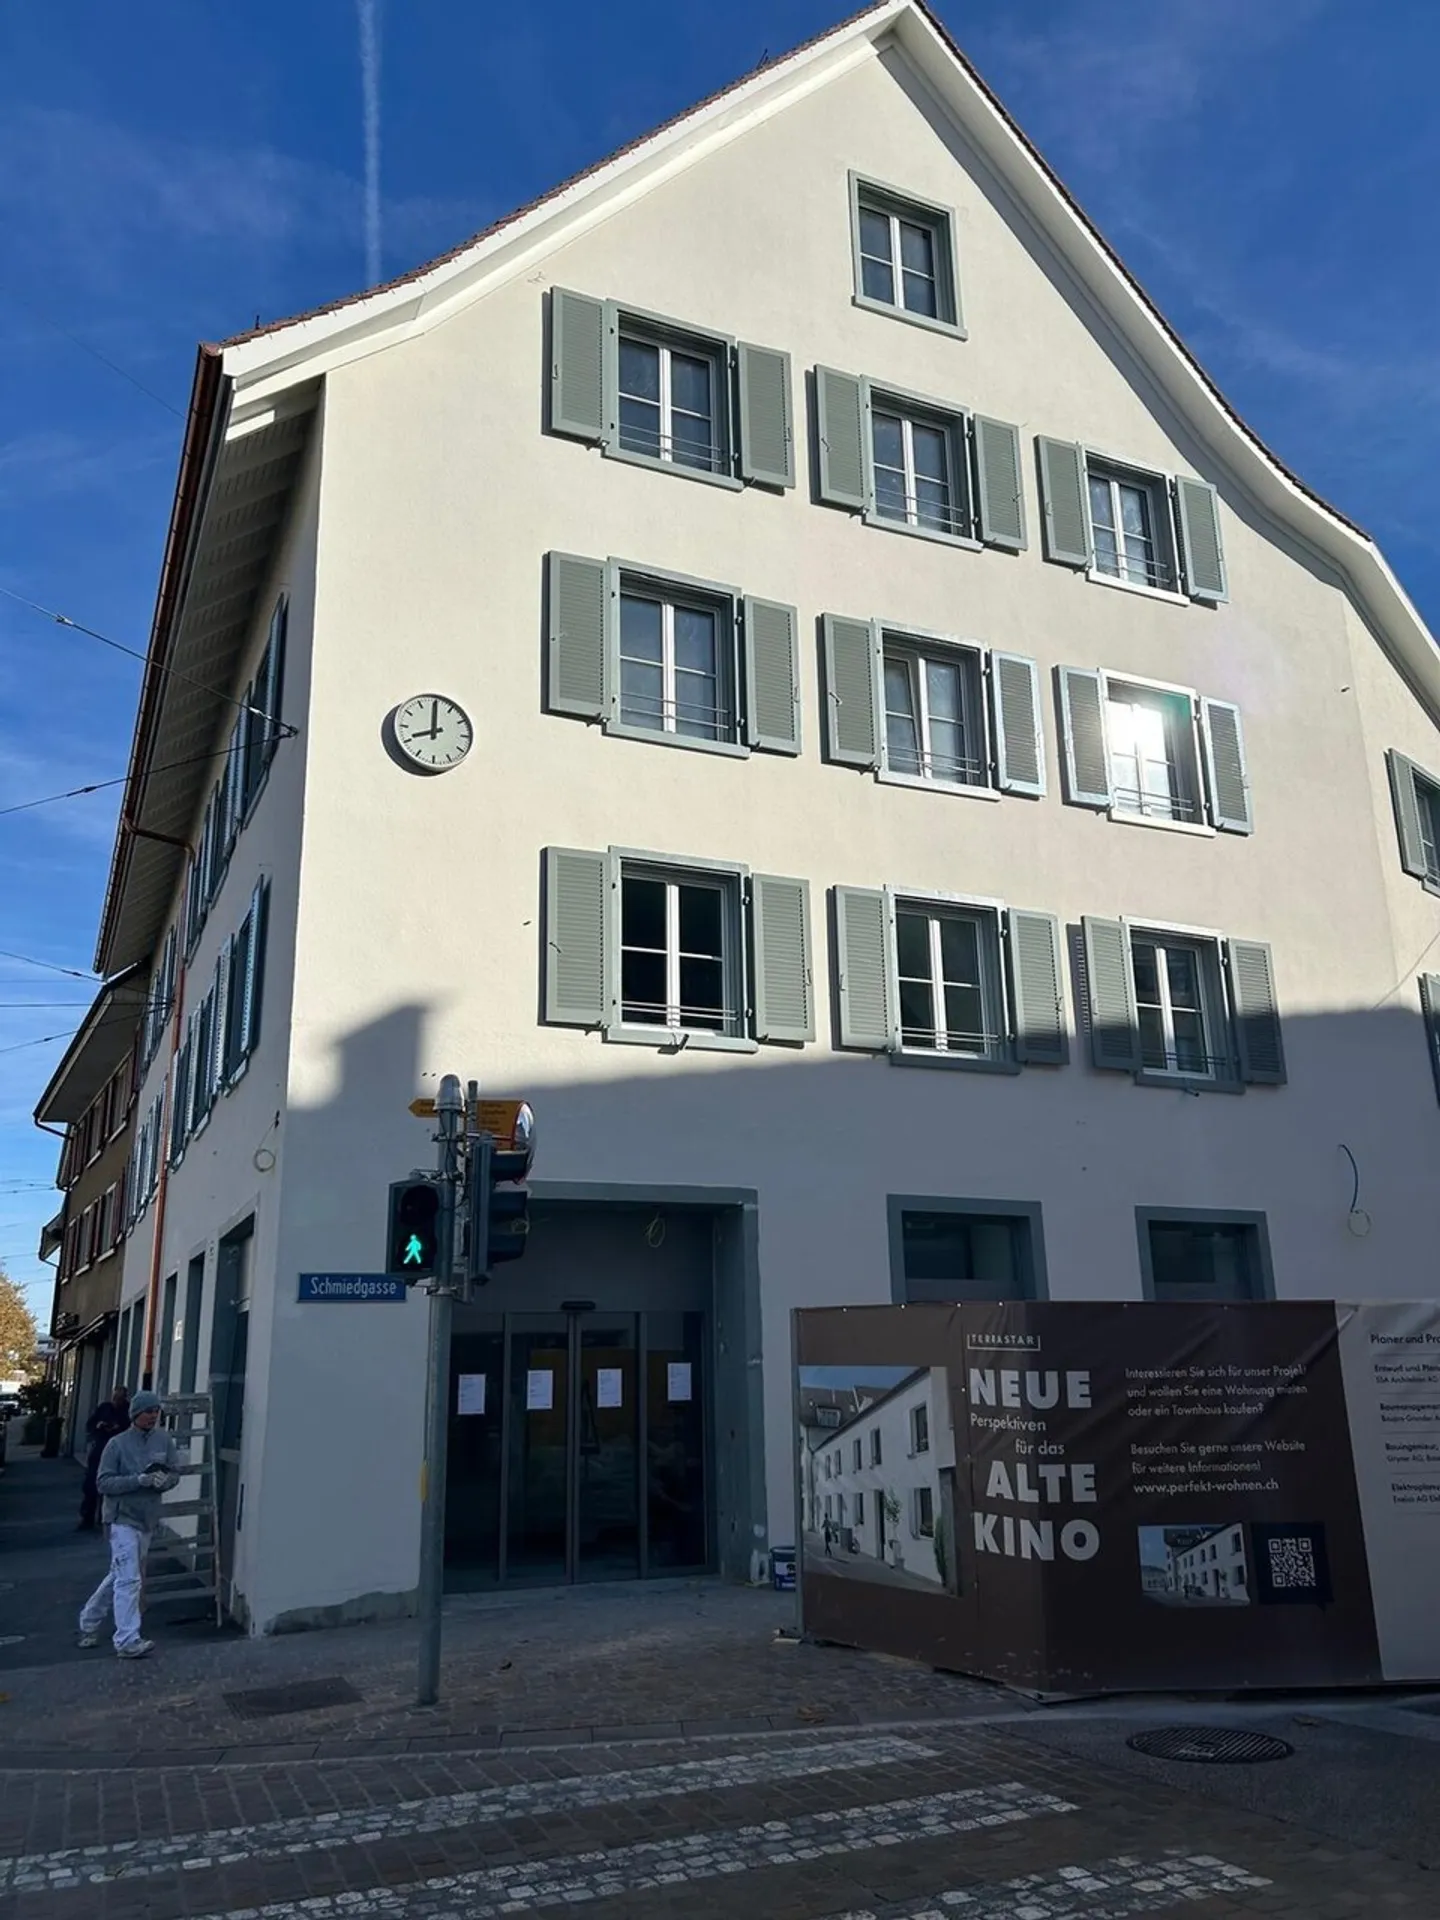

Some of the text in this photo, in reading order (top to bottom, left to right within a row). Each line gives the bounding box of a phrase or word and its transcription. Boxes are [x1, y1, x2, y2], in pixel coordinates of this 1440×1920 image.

[310, 1276, 397, 1299] Schmiedgasse
[1371, 1333, 1403, 1344] Planer
[1405, 1333, 1423, 1344] und
[1124, 1367, 1187, 1379] Interessieren
[1189, 1365, 1205, 1377] Sie
[1207, 1365, 1226, 1377] sich
[1228, 1364, 1242, 1377] für
[1244, 1366, 1271, 1377] unser
[969, 1368, 1092, 1410] NEUE
[1127, 1385, 1146, 1398] und
[1148, 1384, 1182, 1397] wollen
[1183, 1384, 1199, 1396] Sie
[1201, 1384, 1222, 1396] eine
[1224, 1383, 1275, 1398] Wohnung
[1128, 1401, 1264, 1417] oder ein Townhaus kaufen?
[970, 1412, 1047, 1433] Perspektiven
[1015, 1438, 1065, 1455] für das
[1130, 1440, 1307, 1457] Besuchen Sie gerne unsere Website
[1132, 1459, 1262, 1474] für weitere Informationen!
[986, 1460, 1097, 1503] ALTE
[1133, 1478, 1280, 1496] www.perfekt-wohnen.ch
[973, 1511, 1100, 1561] KINO
